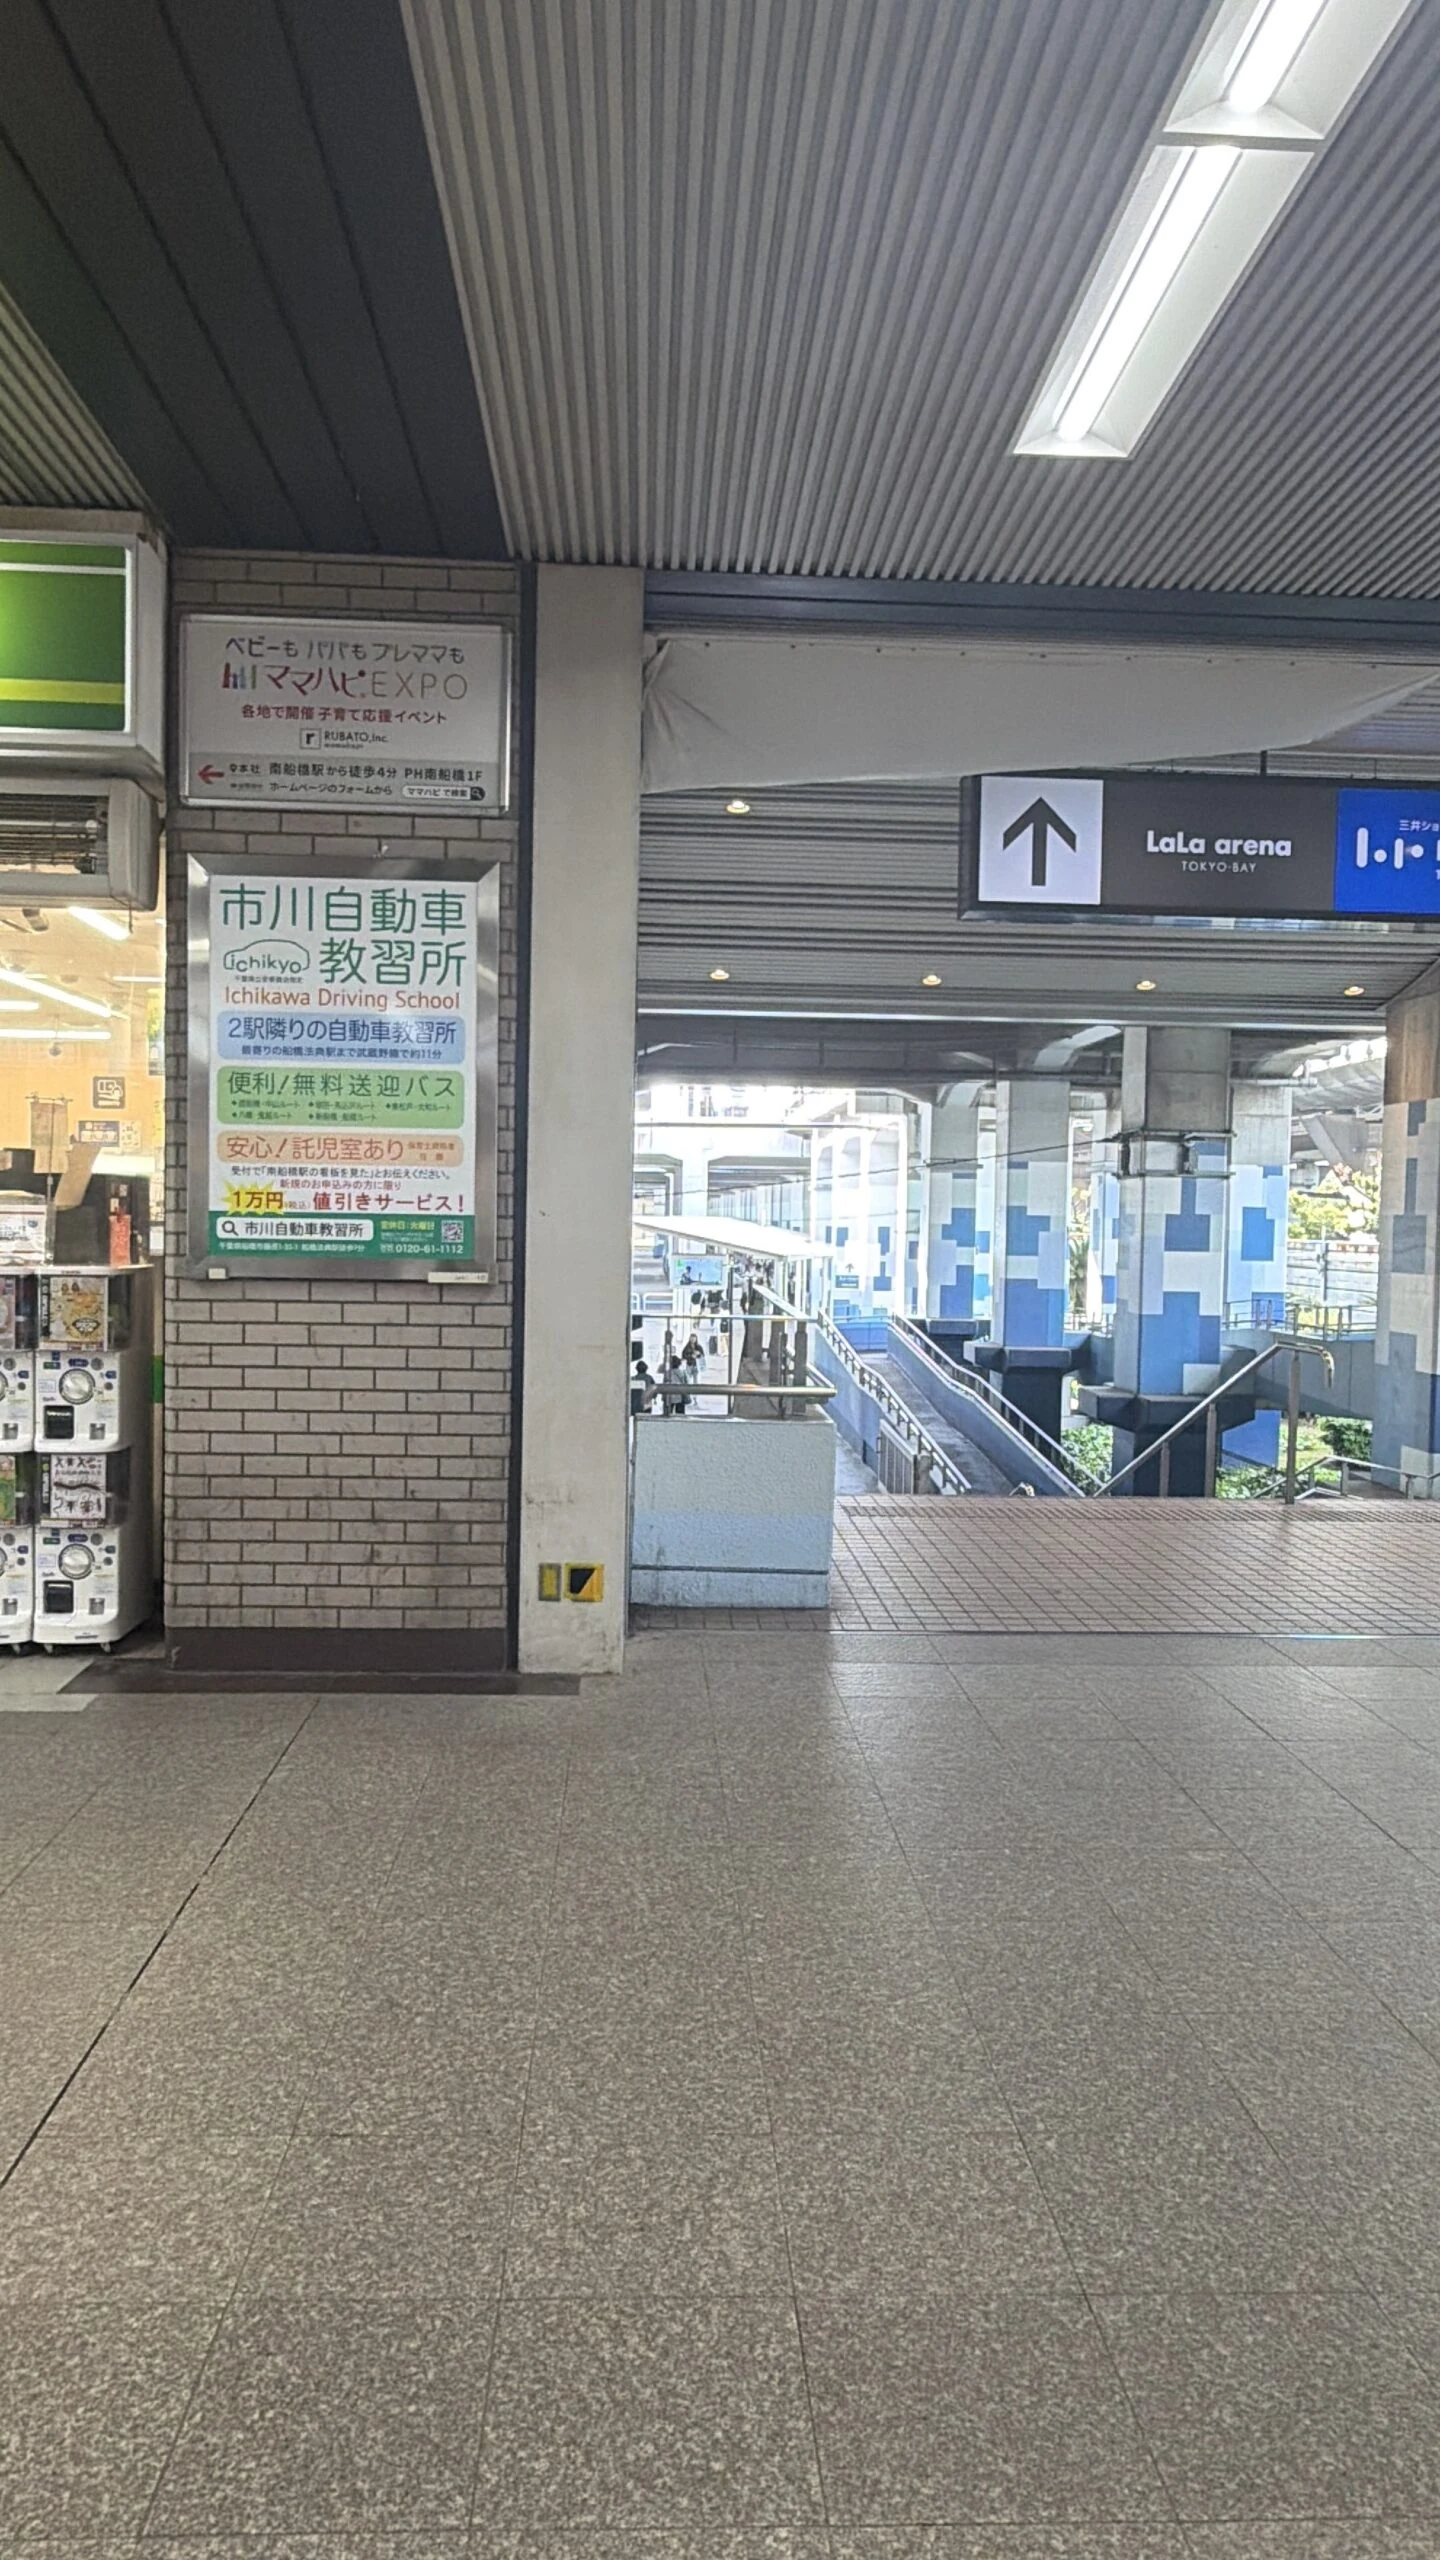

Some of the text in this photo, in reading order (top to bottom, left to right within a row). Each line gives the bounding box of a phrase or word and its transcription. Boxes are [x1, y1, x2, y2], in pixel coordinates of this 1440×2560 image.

[226, 636, 298, 658] ベビーも
[372, 671, 467, 699] EXPO
[1146, 830, 1292, 857] LaLa arena
[219, 882, 467, 936] 市川自動車
[230, 953, 302, 974] ichikyo
[319, 936, 467, 987] 教習所
[225, 986, 460, 1012] Ichikawa Driving School
[228, 1016, 457, 1044] 2駅隣りの自動車教習所
[233, 1191, 284, 1209] 1万円
[245, 1221, 363, 1238] 市川自動車教習所
